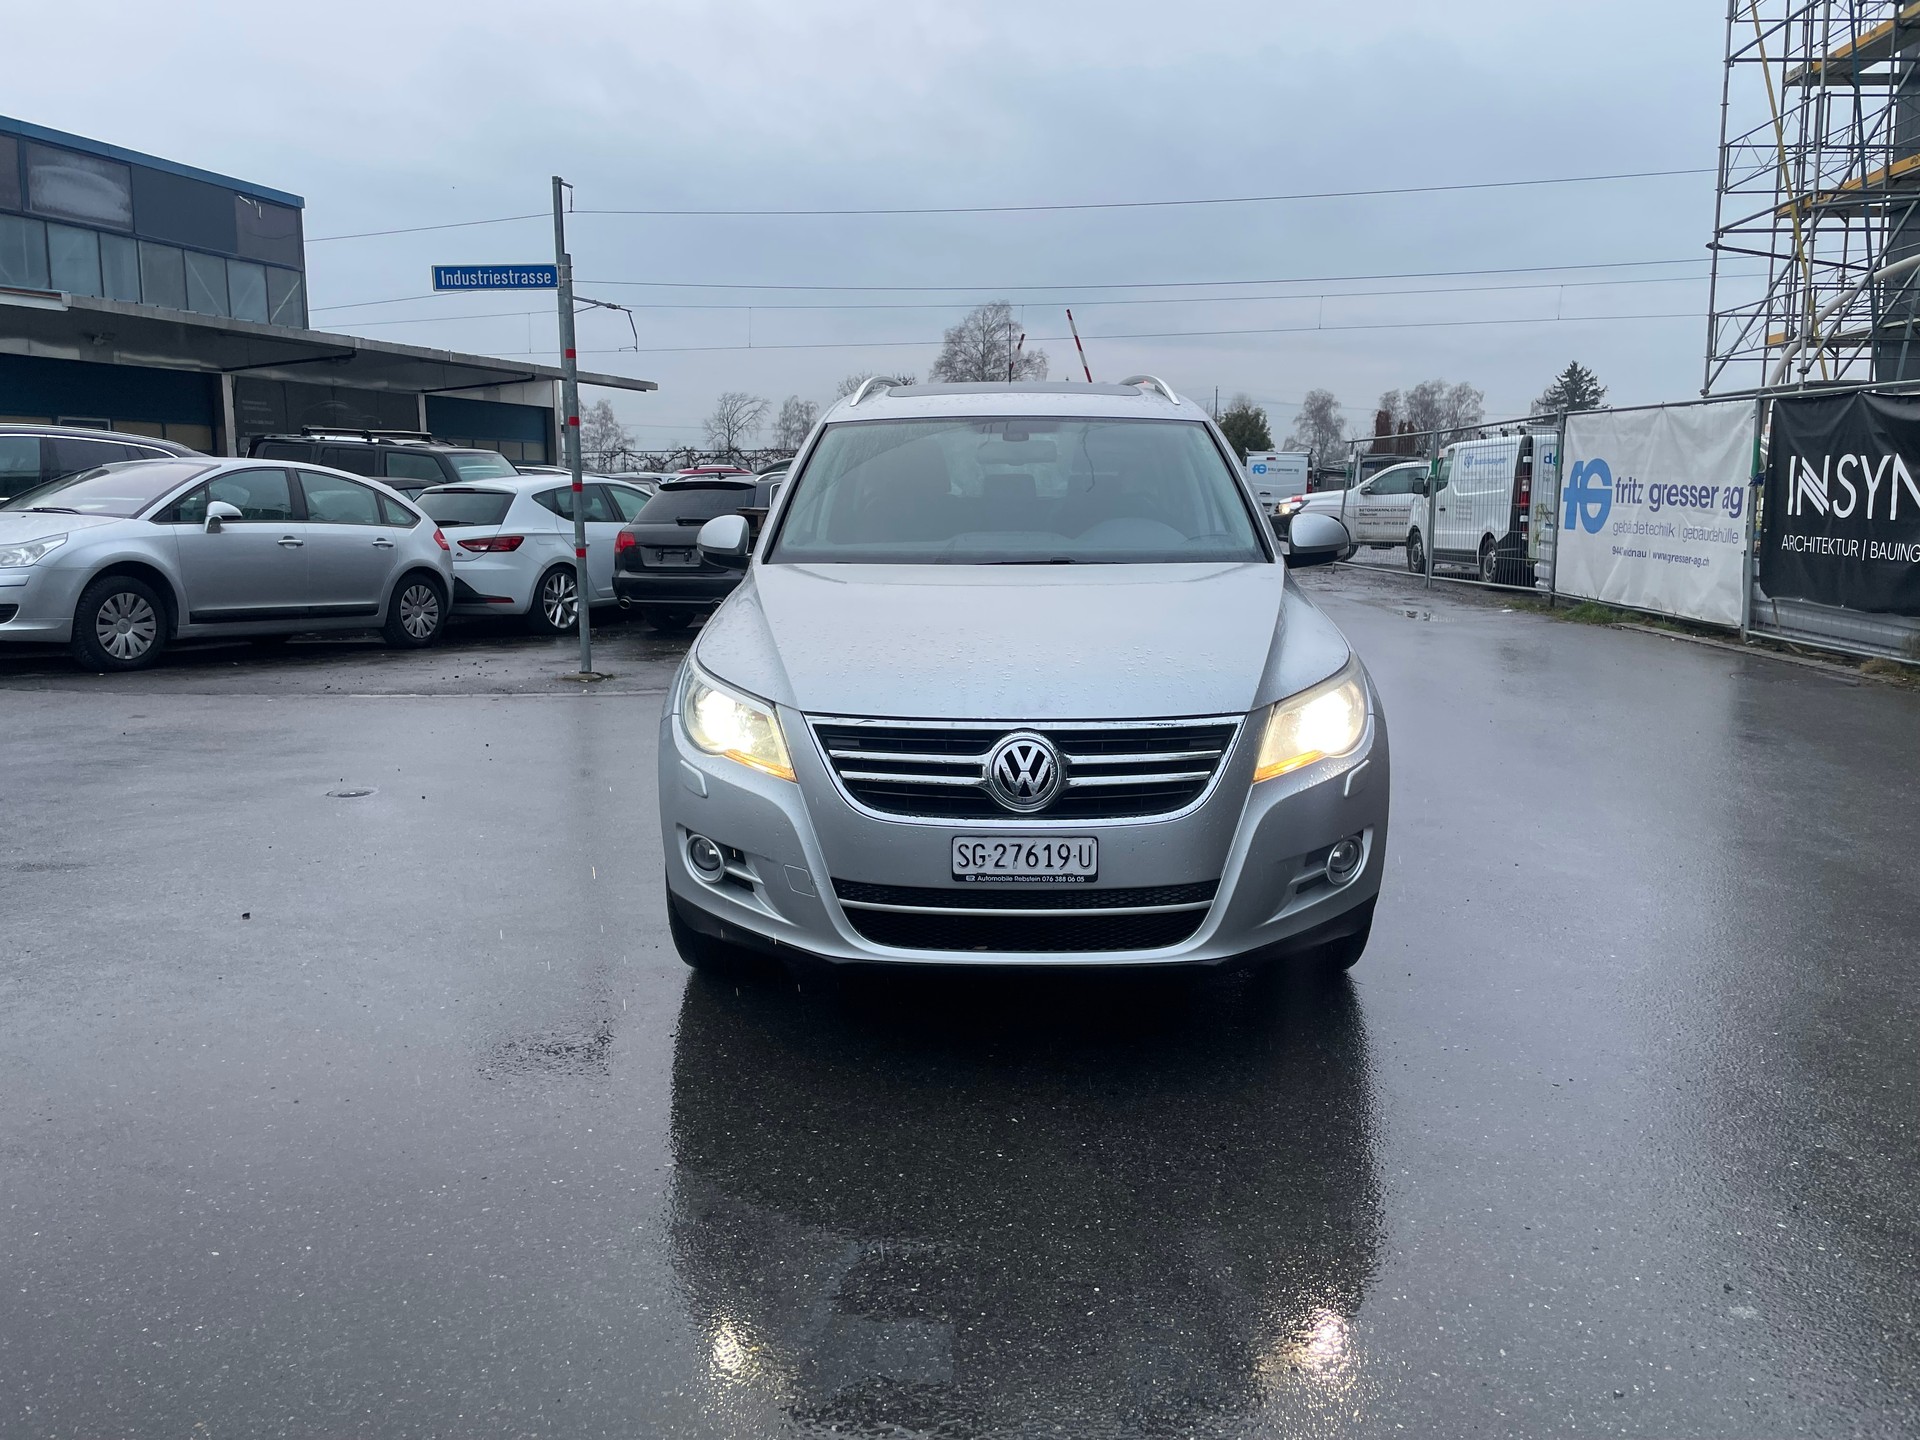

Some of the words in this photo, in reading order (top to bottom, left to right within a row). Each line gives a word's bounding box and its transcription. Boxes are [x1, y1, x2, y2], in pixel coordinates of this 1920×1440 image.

[441, 270, 551, 286] Industriestrasse
[1615, 477, 1644, 504] fritz
[1649, 483, 1719, 512] gresser
[1722, 486, 1744, 518] ag
[1781, 534, 1859, 557] ARCHITEKTUR
